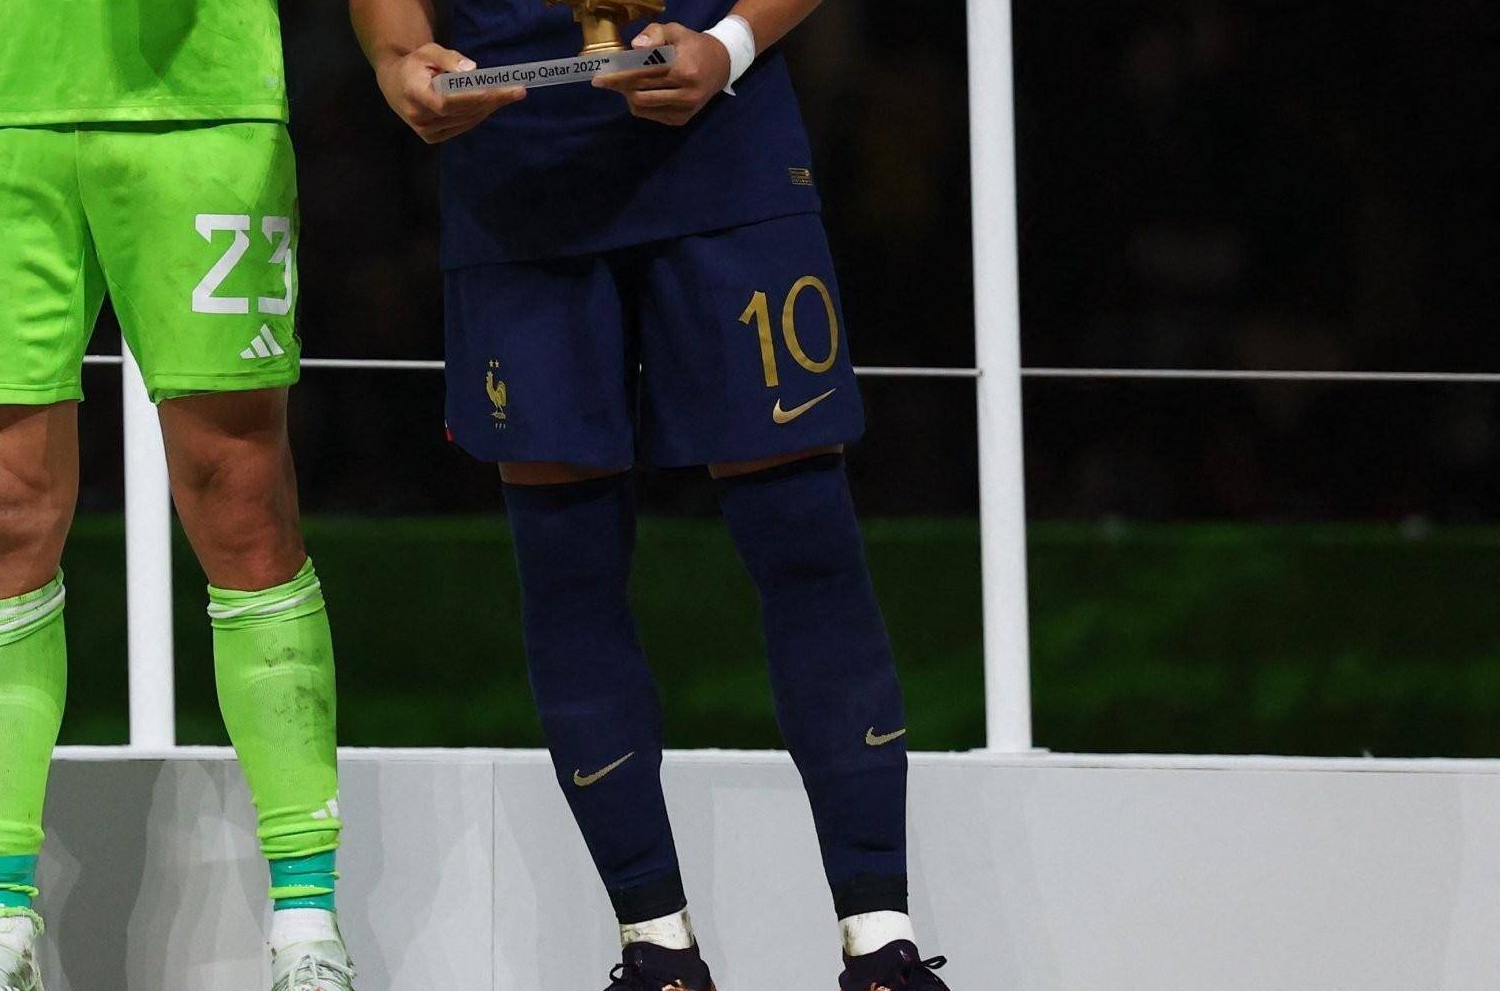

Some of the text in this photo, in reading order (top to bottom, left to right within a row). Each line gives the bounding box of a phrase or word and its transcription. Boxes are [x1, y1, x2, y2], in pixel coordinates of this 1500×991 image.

[449, 76, 473, 89] FIFA
[474, 72, 510, 86] World
[512, 70, 536, 81] Cup
[538, 65, 570, 78] Qatar
[191, 214, 293, 316] 23
[738, 275, 839, 388] 10
